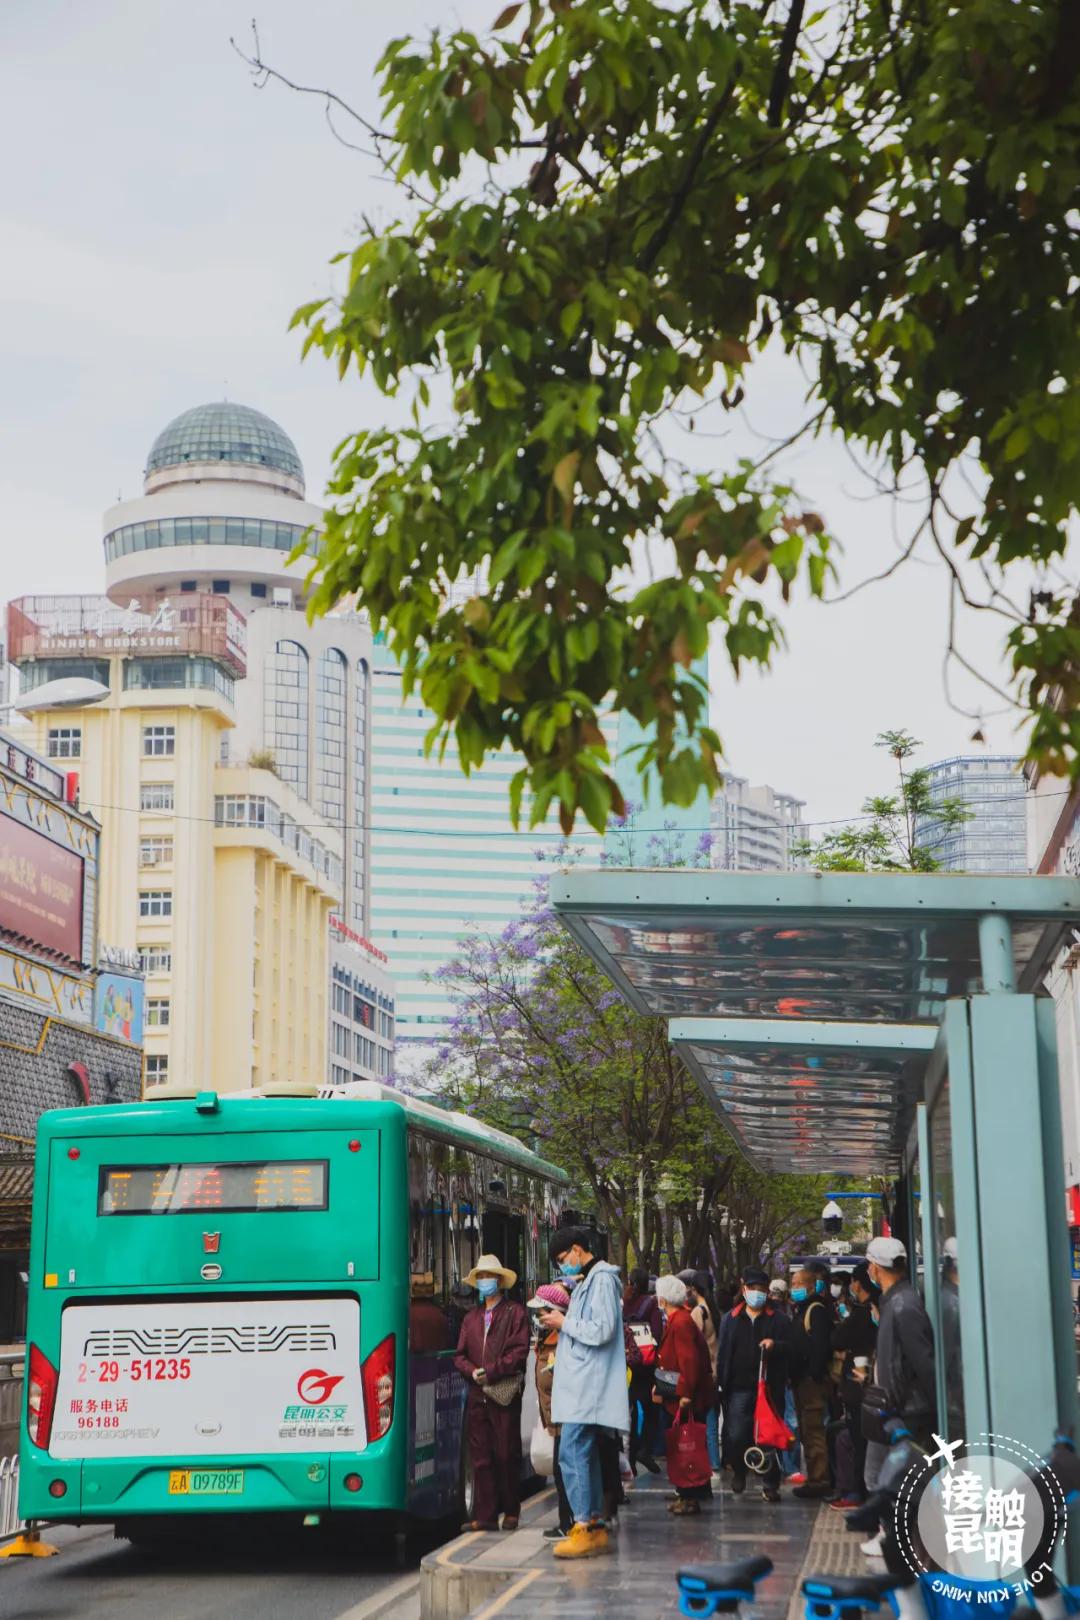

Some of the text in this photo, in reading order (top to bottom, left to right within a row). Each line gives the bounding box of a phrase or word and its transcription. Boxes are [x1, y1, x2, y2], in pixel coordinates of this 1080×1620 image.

[104, 636, 181, 648] BOOKSTORE
[70, 1399, 129, 1413] 服务电话
[283, 1405, 348, 1420] 昆明公交
[78, 1416, 119, 1428] 96188
